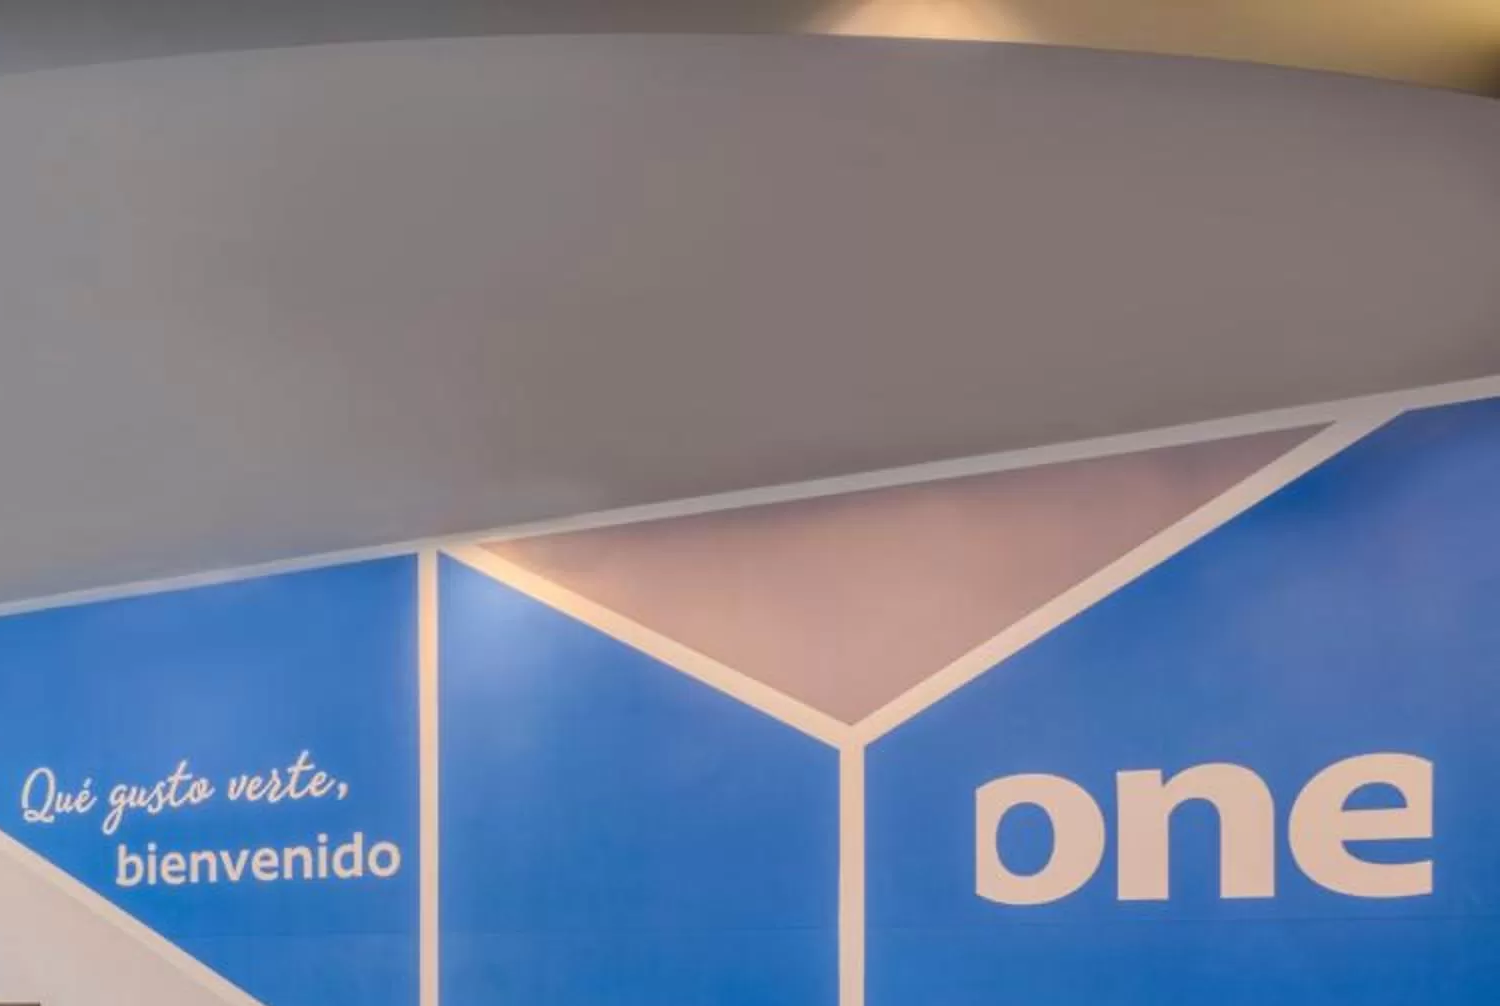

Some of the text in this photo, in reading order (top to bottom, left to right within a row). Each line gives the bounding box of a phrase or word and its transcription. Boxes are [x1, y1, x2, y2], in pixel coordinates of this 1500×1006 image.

[21, 749, 349, 836] Qué gusto verte,
[975, 752, 1433, 906] one
[115, 831, 401, 887] bienvenido
